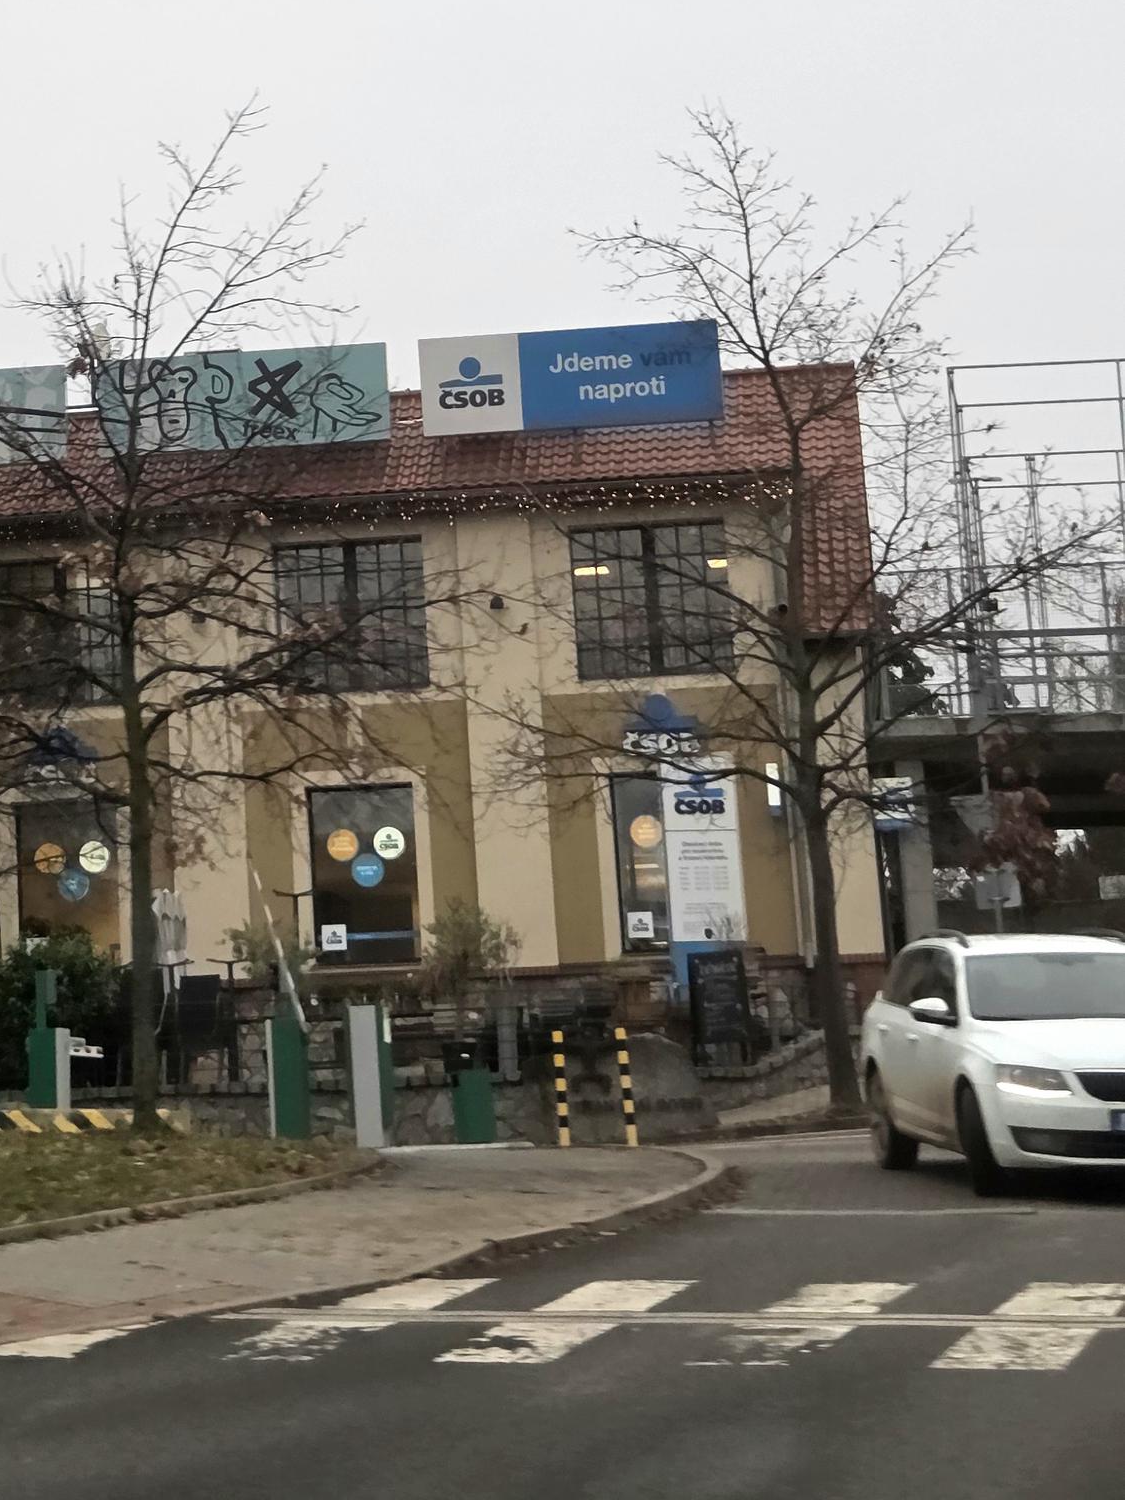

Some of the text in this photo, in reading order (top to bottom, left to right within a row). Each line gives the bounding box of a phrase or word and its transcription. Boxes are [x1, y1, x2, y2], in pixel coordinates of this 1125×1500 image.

[548, 345, 693, 375] Jdeme vám
[438, 389, 506, 410] ČSOB
[578, 375, 667, 403] naproti
